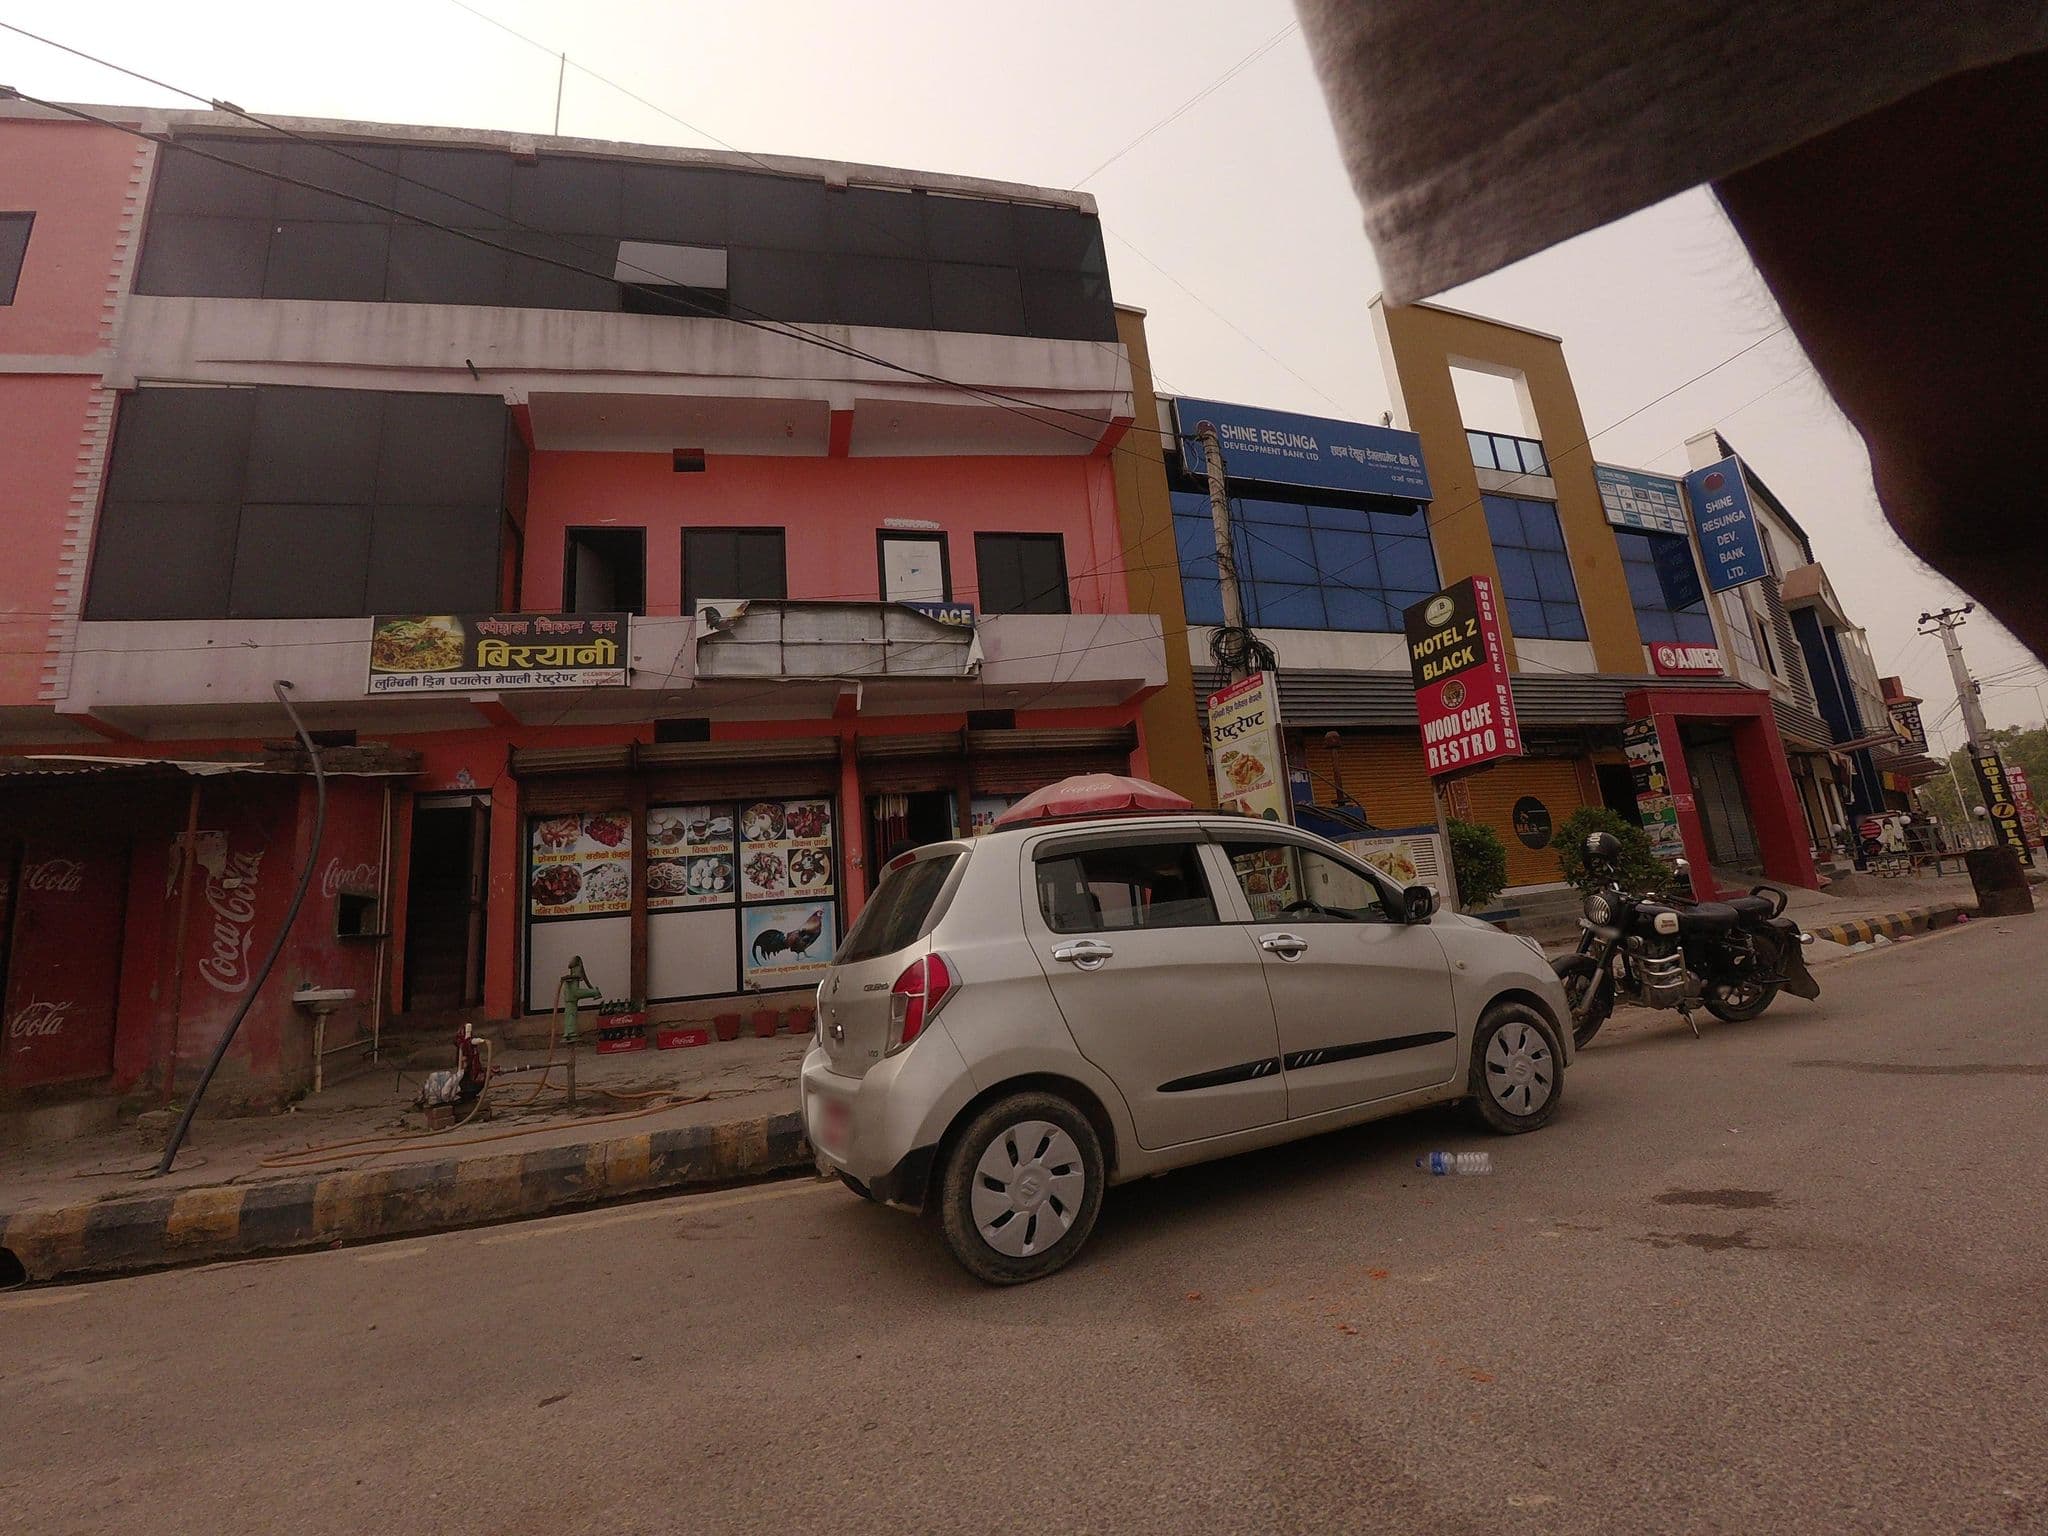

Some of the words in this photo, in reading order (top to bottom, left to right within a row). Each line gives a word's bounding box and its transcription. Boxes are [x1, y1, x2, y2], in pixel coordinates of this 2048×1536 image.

[1220, 424, 1258, 442] SHINE
[1261, 429, 1319, 451] RESUNGA
[1223, 441, 1281, 456] DEVELOPMENT
[1283, 449, 1305, 459] BANK
[1705, 495, 1734, 514] SHINE
[1702, 509, 1746, 533] RESUNGA
[1716, 531, 1739, 546] DEV.
[1719, 547, 1745, 564] BANK
[1727, 565, 1747, 580] LTD.
[1413, 626, 1462, 660] HOTEL
[1465, 618, 1477, 637] Z
[477, 638, 618, 668] बिरयानी
[1423, 646, 1476, 681] BLACK
[1476, 580, 1492, 621] WOOD
[1488, 631, 1501, 673] CAFE
[1496, 684, 1515, 749] RESTRO
[496, 672, 530, 685] नेपाली
[1424, 713, 1460, 744] WOOD
[1462, 702, 1492, 733] CAFE
[1428, 729, 1497, 769] RESTRO
[1980, 757, 2007, 802] HOTEL
